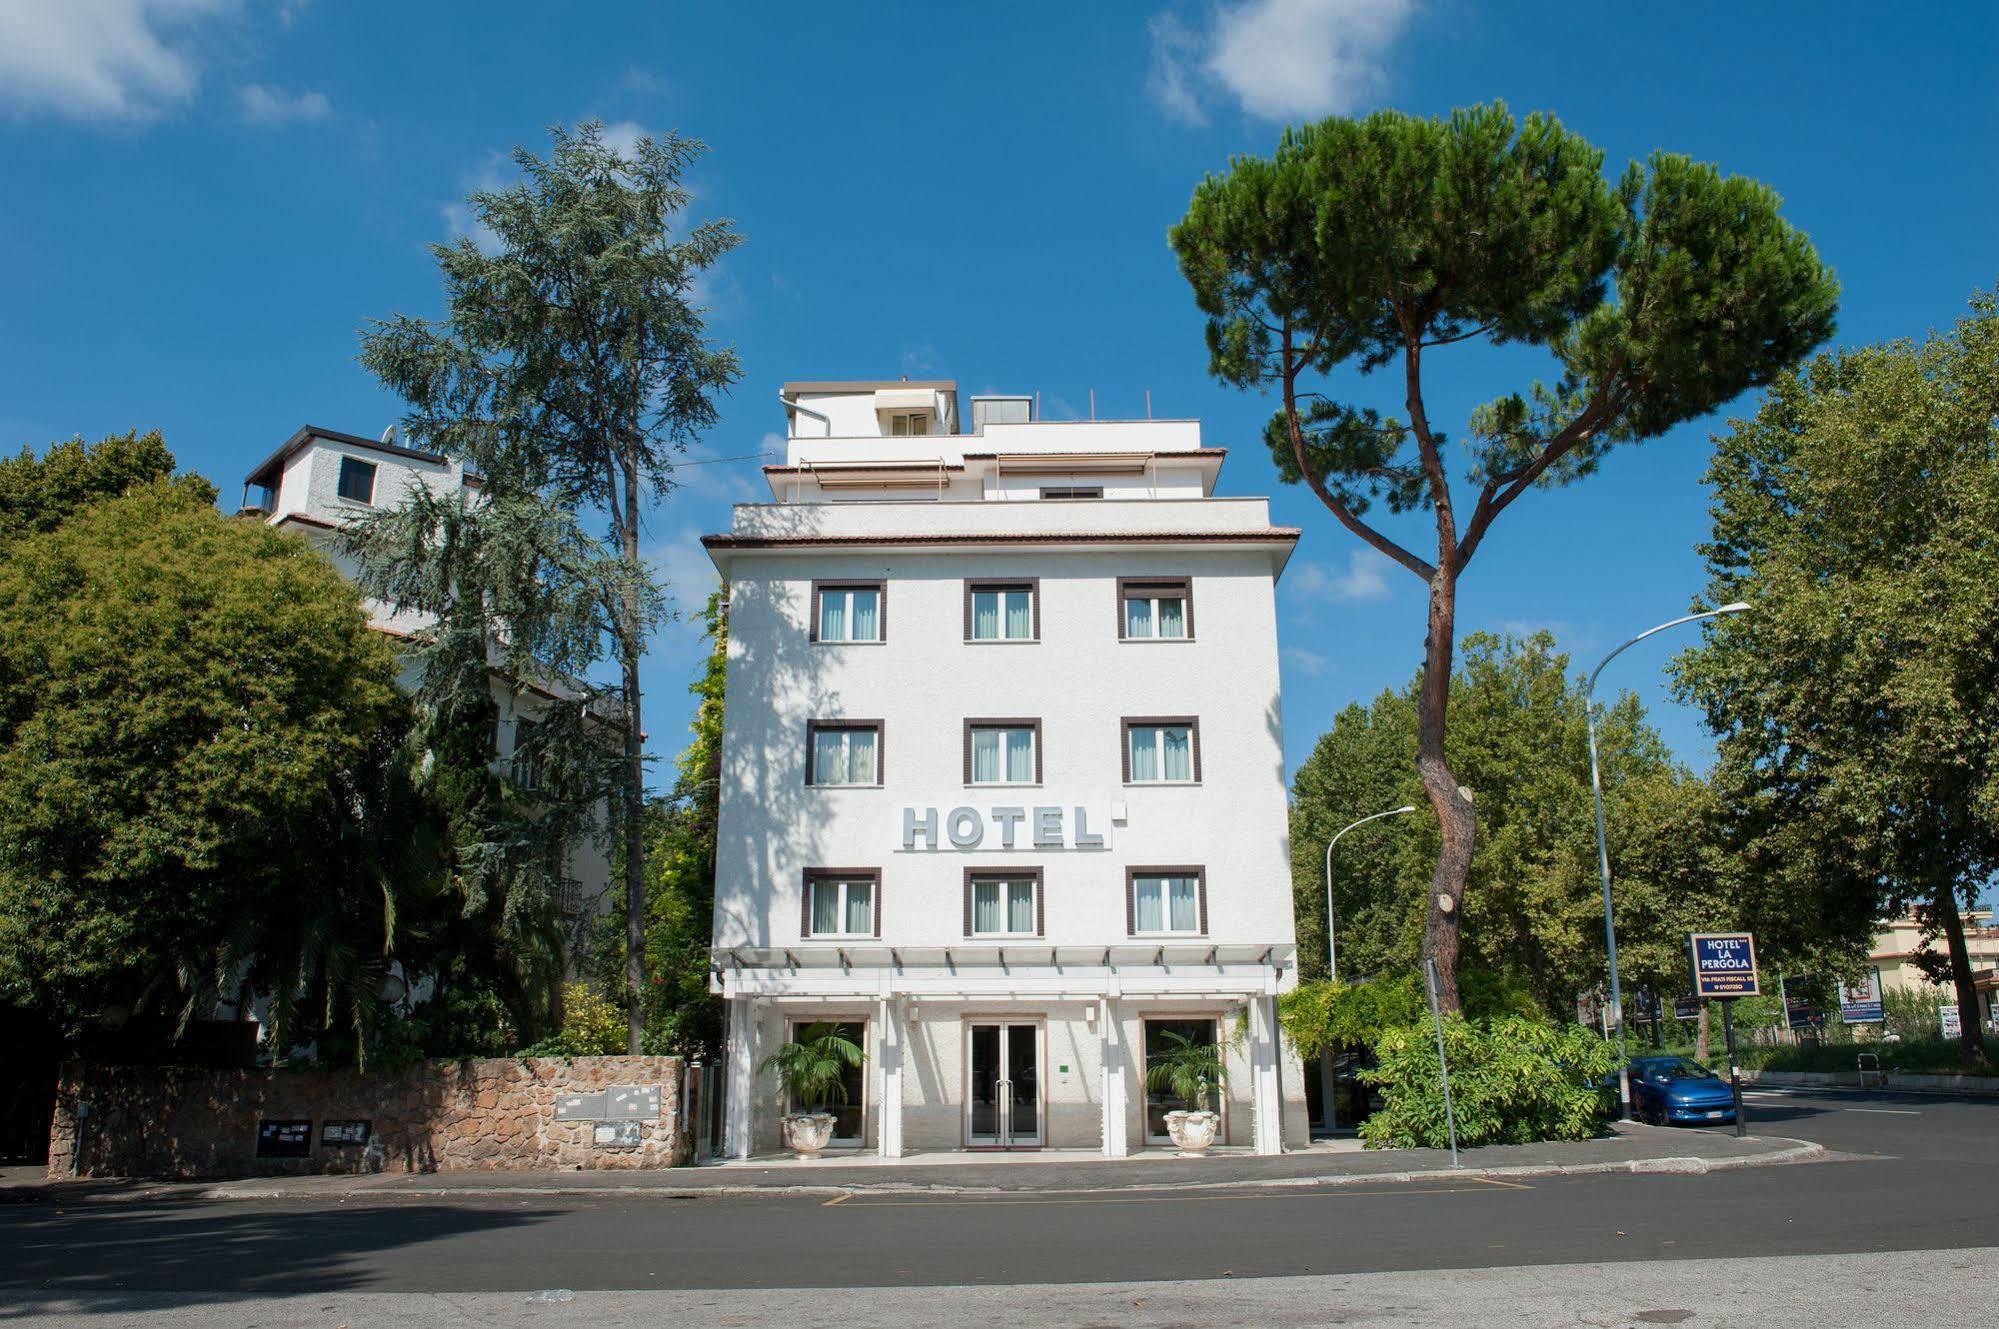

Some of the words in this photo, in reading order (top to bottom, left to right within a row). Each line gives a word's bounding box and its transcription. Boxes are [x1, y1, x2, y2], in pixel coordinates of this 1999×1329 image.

[903, 806, 1104, 848] HOTEL
[1707, 940, 1740, 950] HOTEL
[1718, 950, 1732, 959] LA
[1701, 959, 1749, 969] PERGOLA
